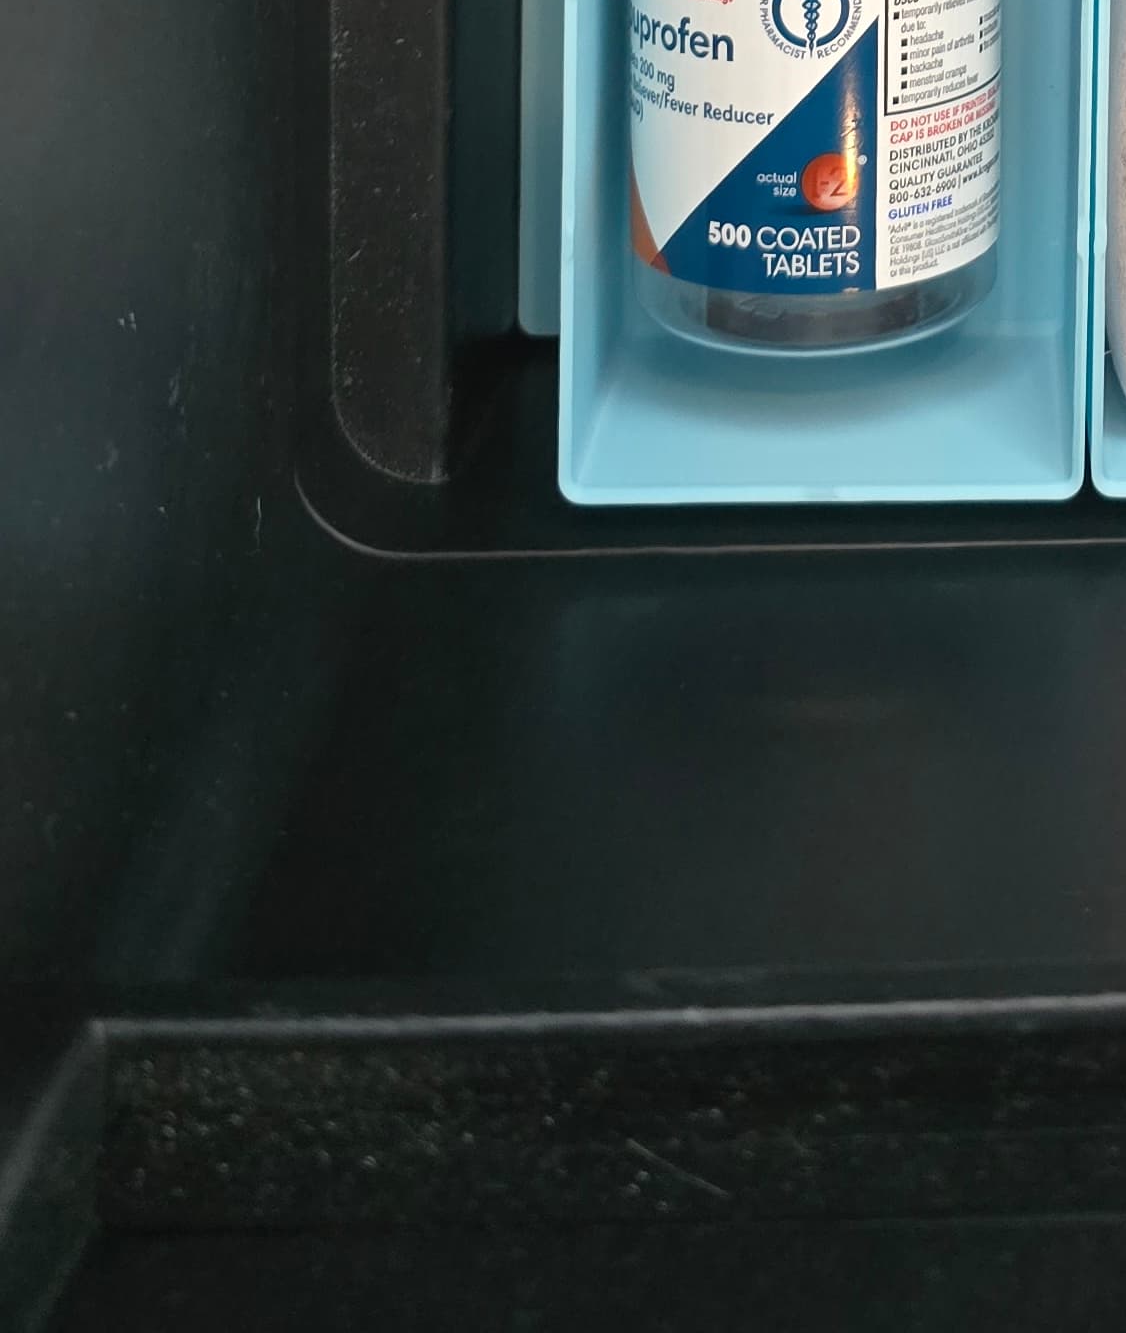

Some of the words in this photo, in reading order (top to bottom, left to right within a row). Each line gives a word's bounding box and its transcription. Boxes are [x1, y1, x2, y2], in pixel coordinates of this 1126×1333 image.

[632, 6, 734, 62] uprofen
[760, 7, 807, 60] PHARMACIST
[901, 21, 915, 34] due
[910, 30, 944, 46] headache
[909, 47, 930, 60] minor
[640, 56, 655, 79] 200
[657, 70, 675, 93] mg
[909, 71, 944, 88] menstrual
[910, 59, 943, 75] backache
[901, 86, 942, 103] temporarily
[703, 102, 775, 125] Reducer
[890, 119, 908, 131] DO
[911, 114, 932, 129] NOT
[934, 108, 951, 124] USE
[952, 105, 960, 117] IF
[889, 136, 957, 161] DISTRIBUTED
[958, 132, 968, 144] BY
[969, 126, 982, 139] THE
[890, 132, 913, 144] CAP
[916, 129, 925, 139] IS
[927, 117, 962, 138] BROKEN
[889, 148, 956, 174] CINCINNATI,
[957, 140, 978, 157] OHIO
[756, 172, 797, 184] actual
[889, 170, 935, 191] QUALITY
[937, 151, 983, 179] GUARANTEE
[773, 185, 797, 197] size
[889, 178, 956, 204] 800-632-6900
[888, 202, 930, 220] GLUTEN
[931, 194, 953, 210] FREE
[708, 221, 751, 249] 500
[756, 225, 861, 250] COATED
[763, 251, 860, 277] TABLETS
